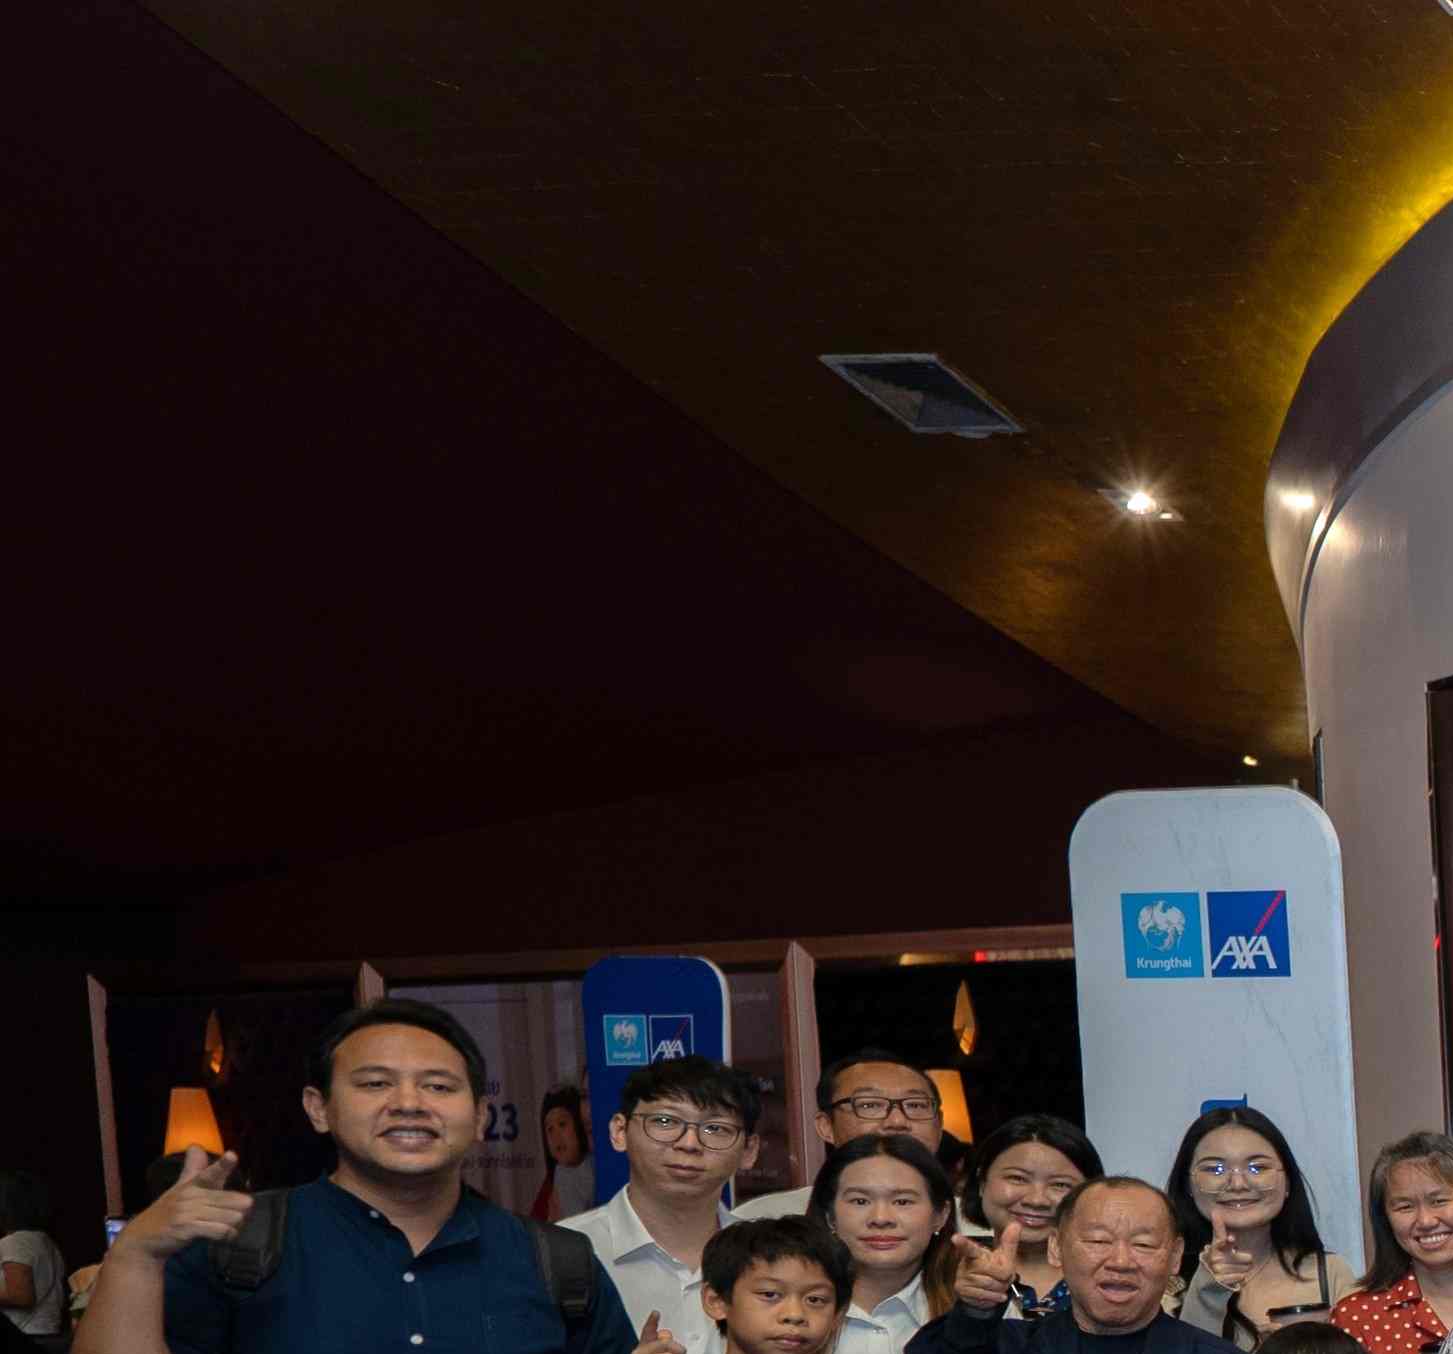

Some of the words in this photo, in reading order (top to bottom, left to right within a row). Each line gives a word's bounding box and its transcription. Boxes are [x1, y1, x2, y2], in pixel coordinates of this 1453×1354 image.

[1212, 935, 1278, 969] AXA
[1137, 956, 1192, 971] Krungthai
[652, 1040, 685, 1060] AXA
